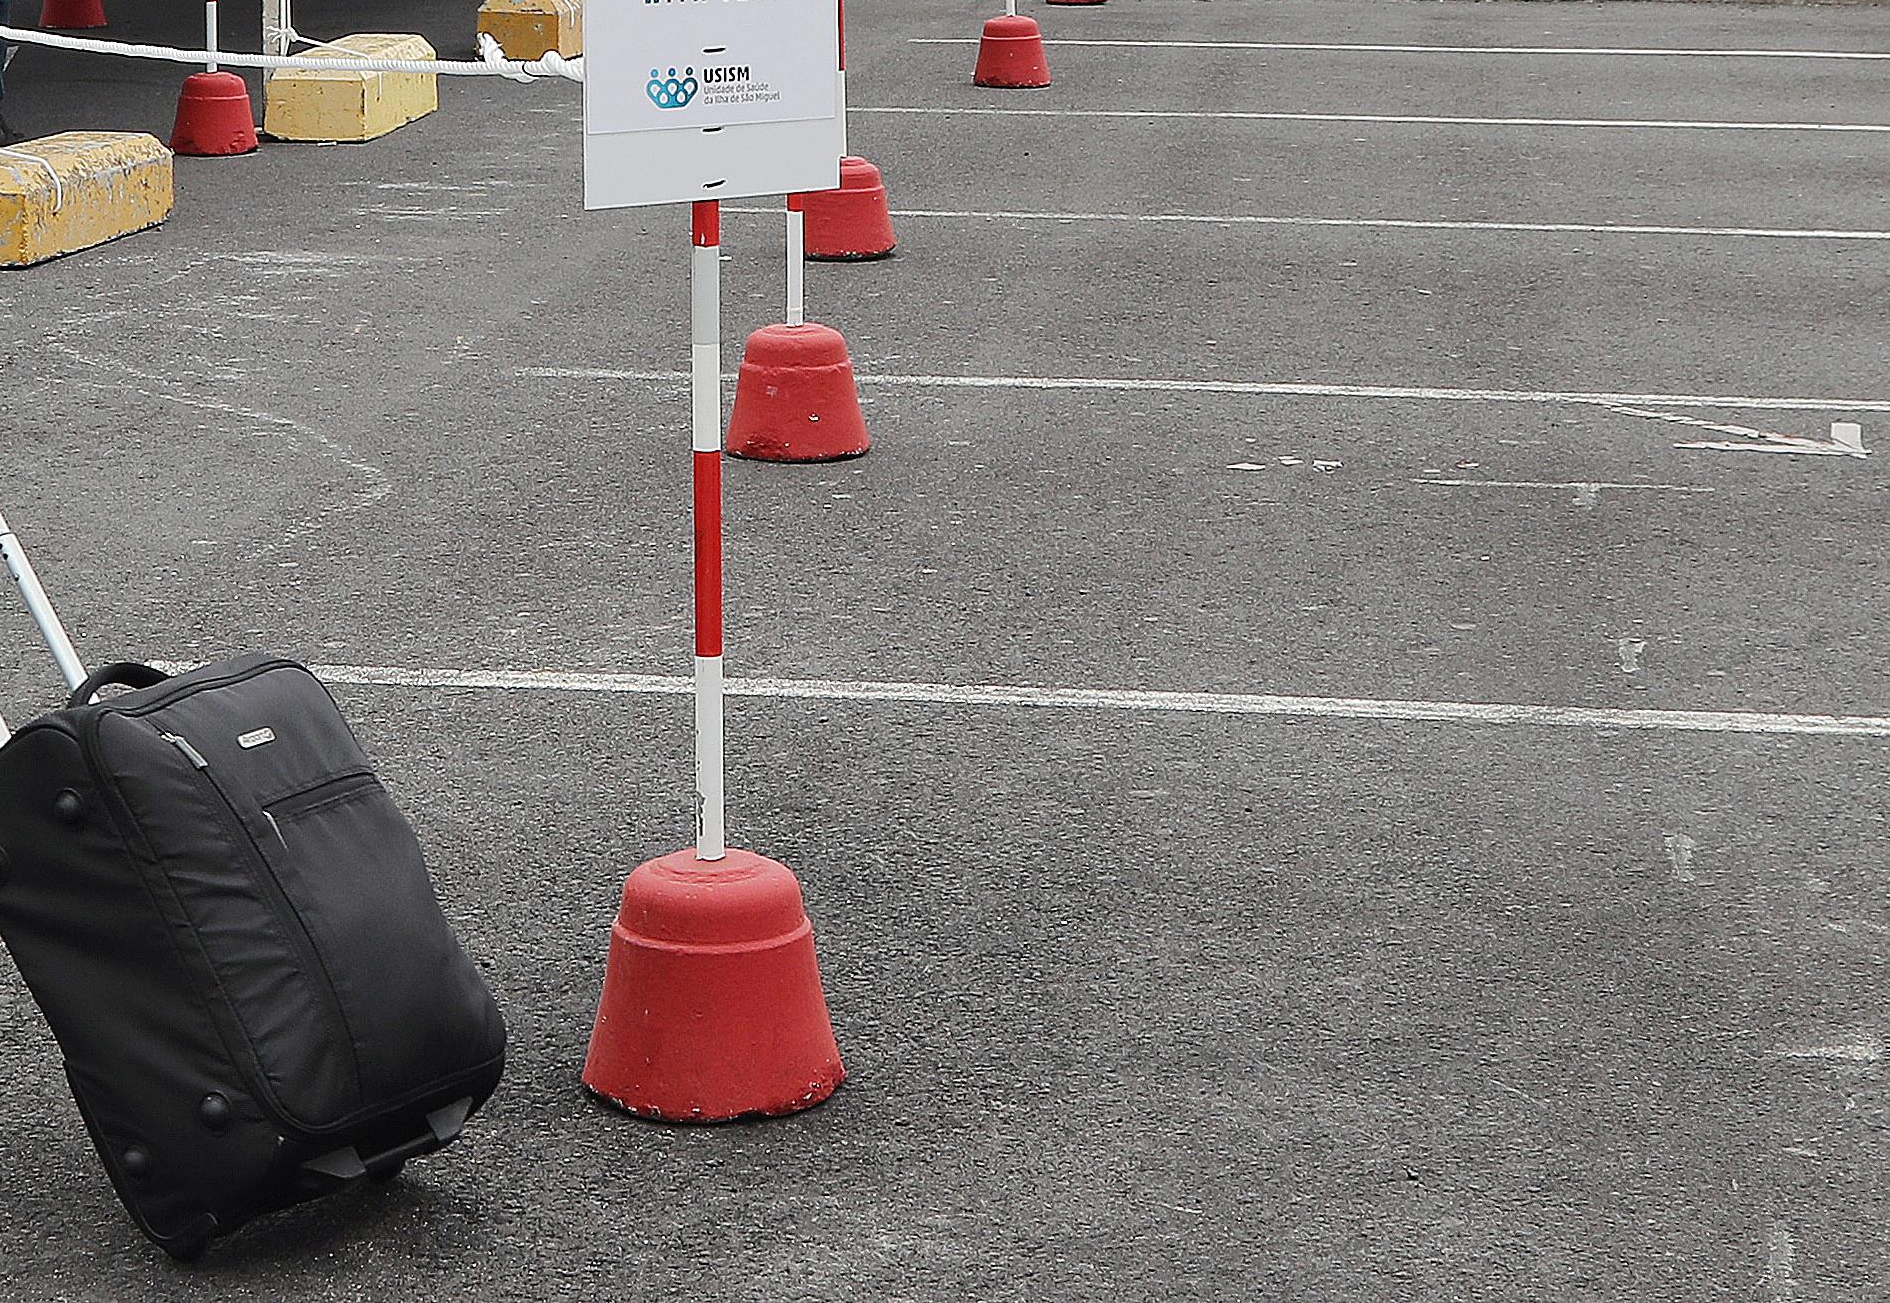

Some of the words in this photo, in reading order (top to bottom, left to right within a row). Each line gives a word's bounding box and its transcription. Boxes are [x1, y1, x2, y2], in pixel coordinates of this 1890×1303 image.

[703, 66, 750, 84] USISM
[735, 84, 745, 93] de
[730, 95, 740, 103] de
